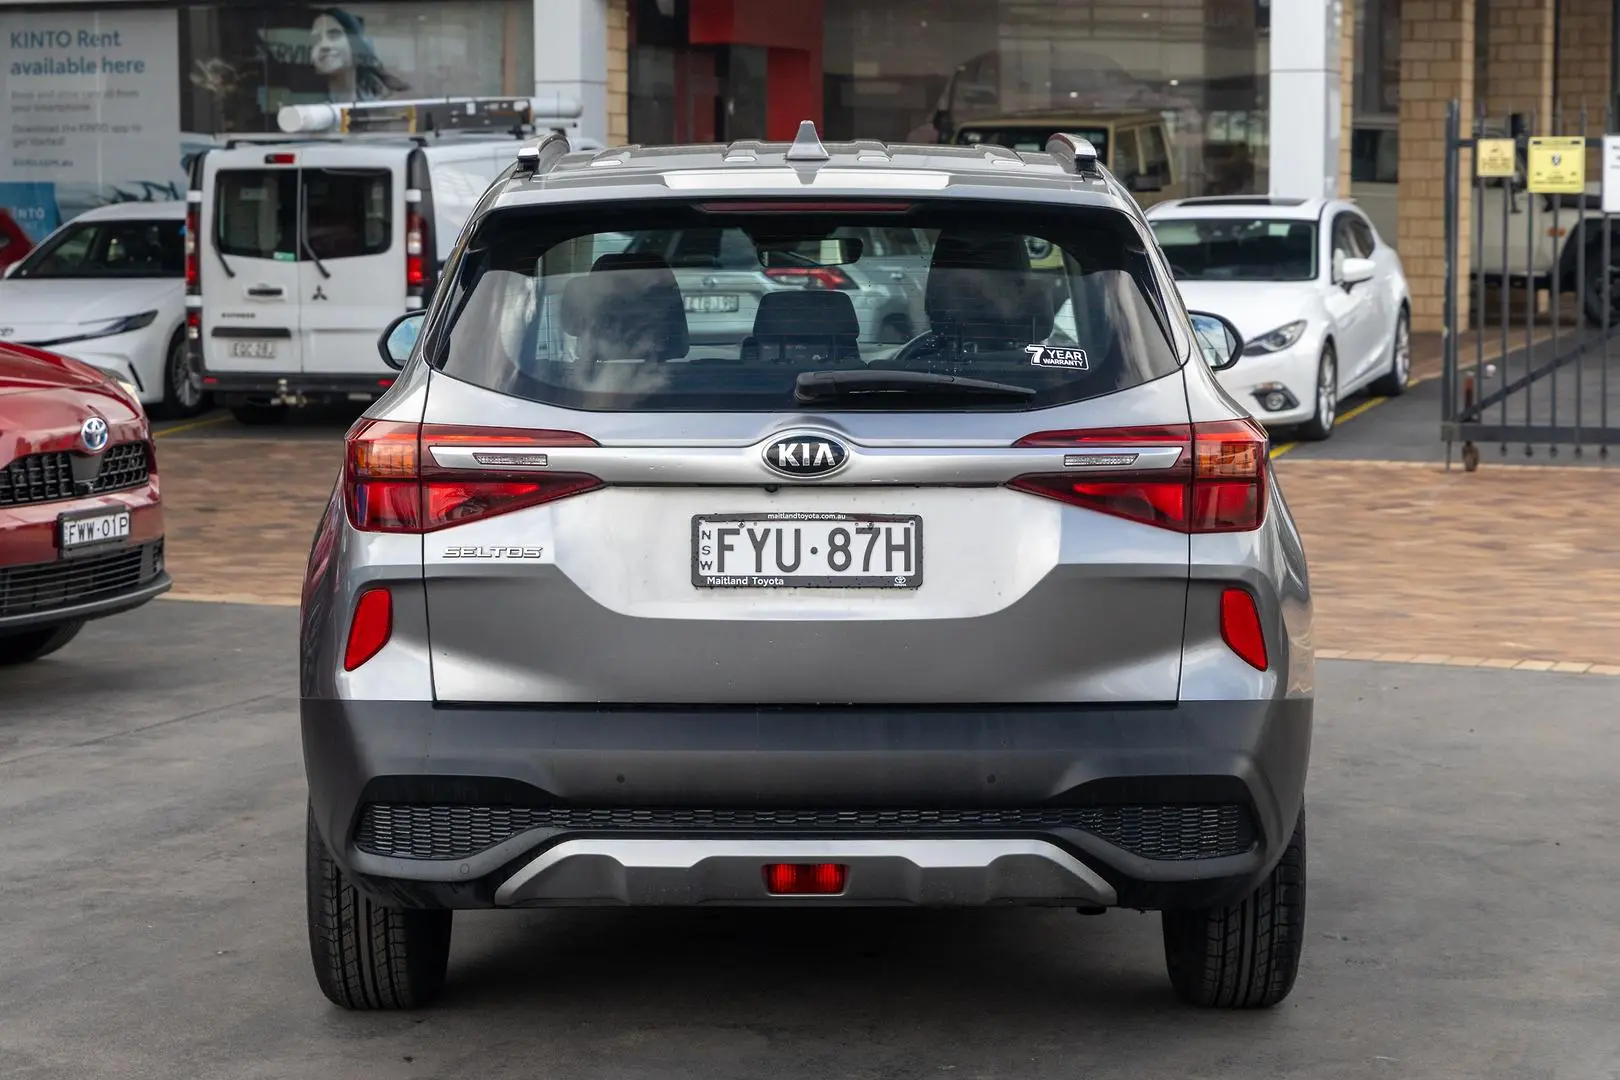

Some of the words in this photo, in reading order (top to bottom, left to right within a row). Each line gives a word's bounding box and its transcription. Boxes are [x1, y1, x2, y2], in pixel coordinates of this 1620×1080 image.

[10, 30, 73, 49] KINTO
[77, 29, 122, 48] Rent
[10, 57, 97, 76] available
[101, 56, 146, 74] here
[1026, 346, 1044, 363] 7
[1047, 349, 1082, 361] YEAR
[1042, 358, 1083, 367] WARRANTY
[777, 442, 836, 467] KIA
[442, 546, 543, 558] SELTOS
[706, 576, 749, 585] Maitland
[752, 576, 784, 586] Toyota
